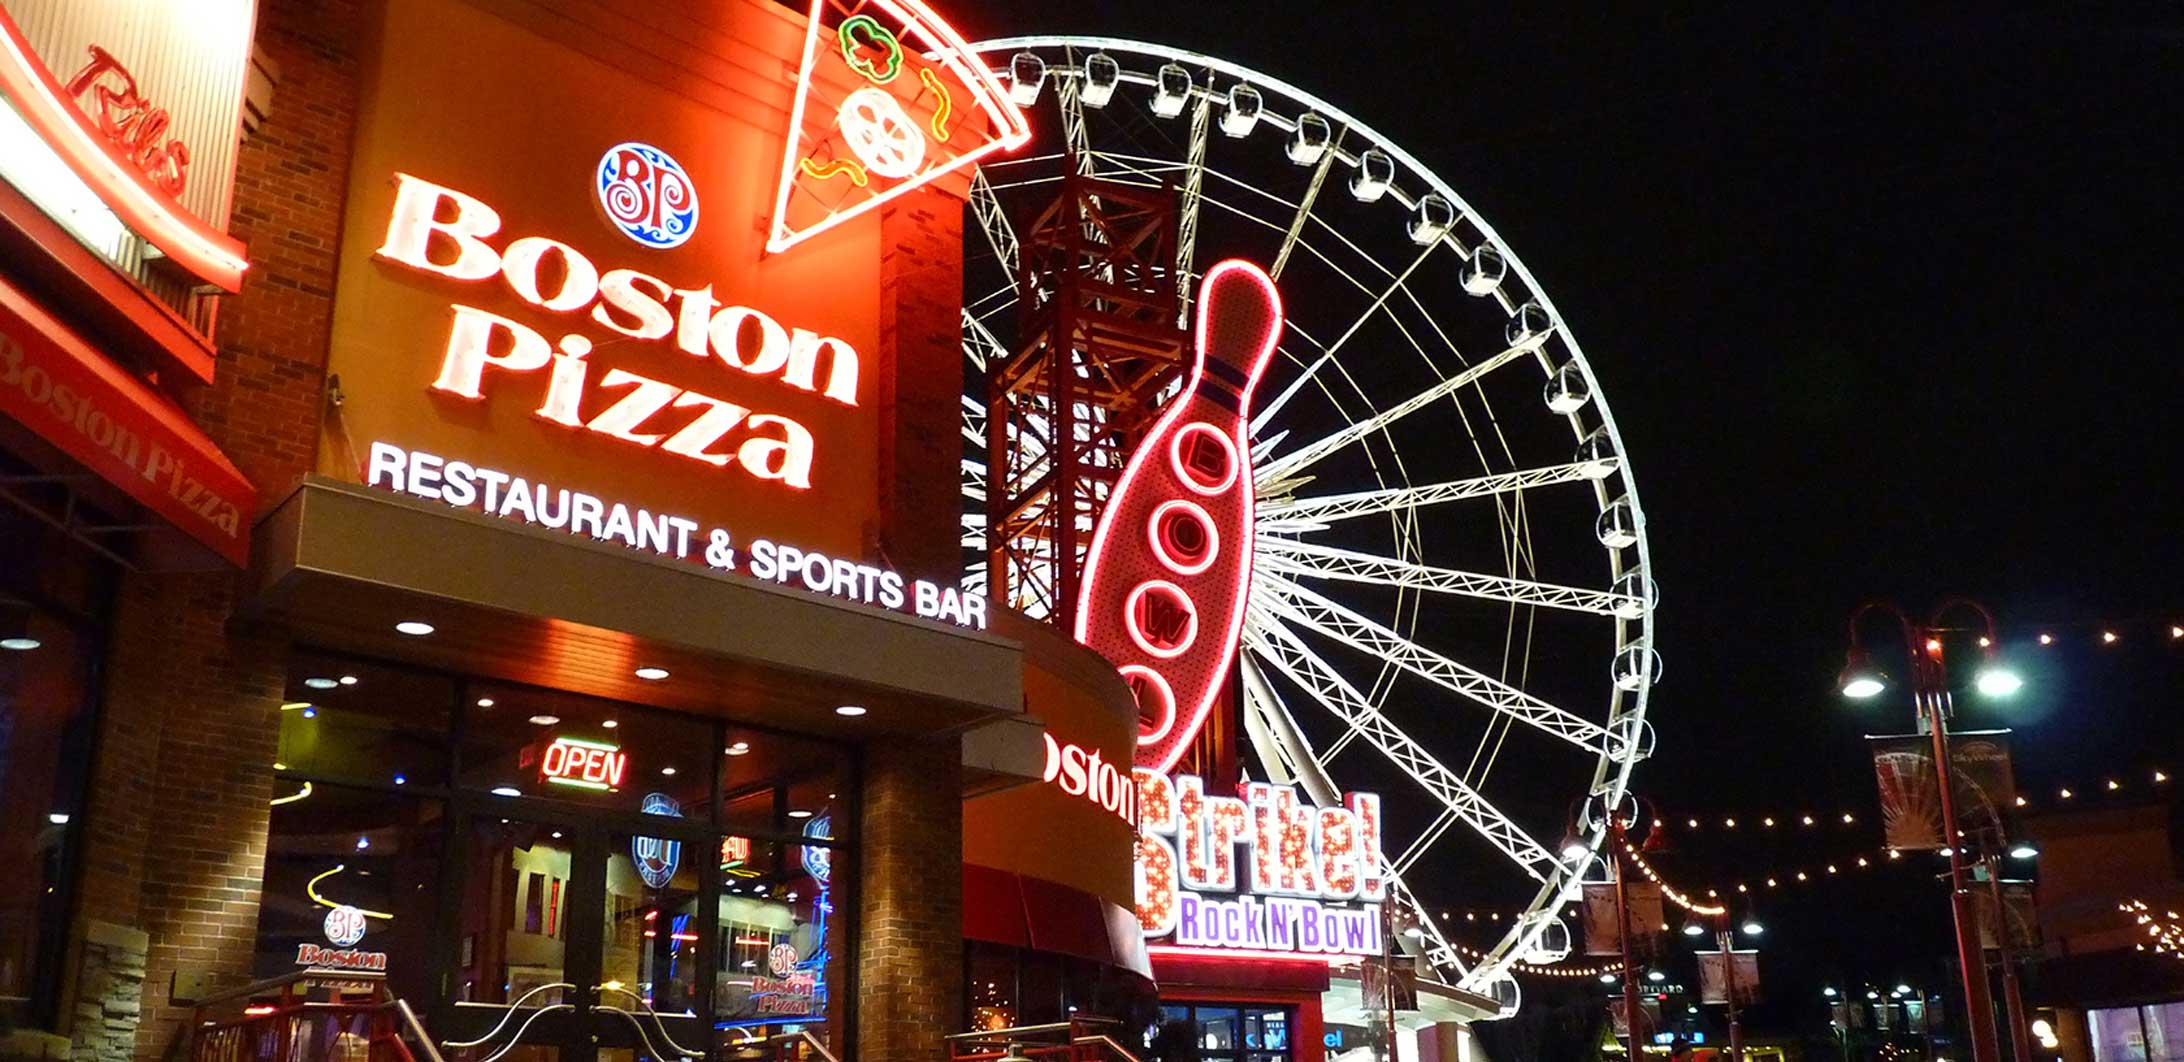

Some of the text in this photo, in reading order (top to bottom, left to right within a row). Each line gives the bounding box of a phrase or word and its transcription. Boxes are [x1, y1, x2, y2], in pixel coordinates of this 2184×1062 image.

[605, 149, 693, 230] BP
[371, 172, 859, 407] Boston
[426, 304, 814, 489] Pizza
[142, 444, 241, 539] Pizza
[368, 441, 988, 630] RESTAURANT & SPORTS BAR
[542, 743, 626, 785] OPEN
[1044, 732, 1136, 827] oston
[1132, 767, 1386, 938] Strike!
[295, 943, 387, 971] Boston
[1180, 896, 1261, 945] Rock
[1301, 904, 1378, 950] Bowl
